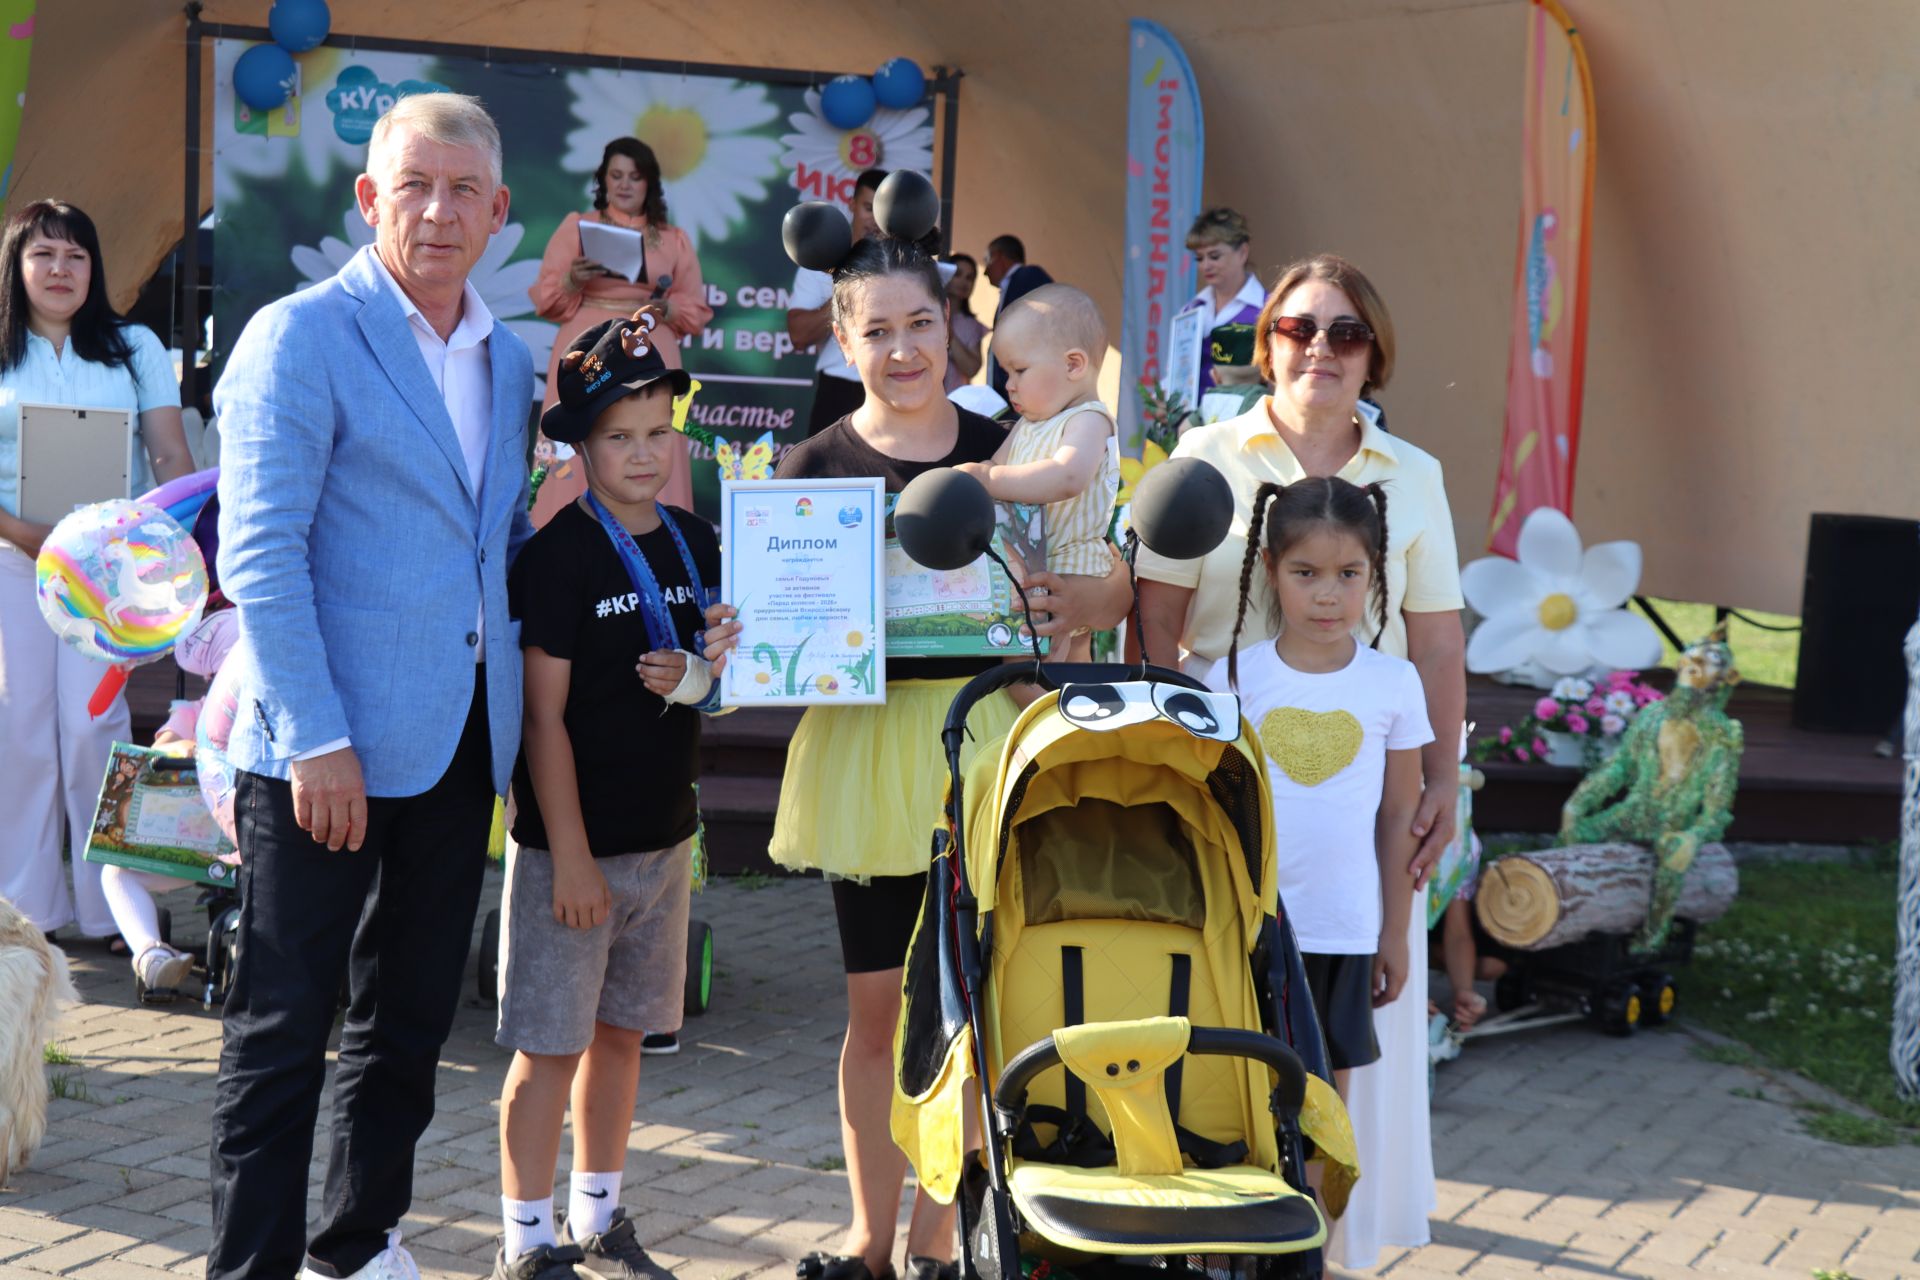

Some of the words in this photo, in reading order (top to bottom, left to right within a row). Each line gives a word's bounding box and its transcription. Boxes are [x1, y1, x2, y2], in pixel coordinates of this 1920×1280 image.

[849, 133, 877, 166] 8
[736, 285, 794, 310] сем
[691, 403, 795, 429] частье
[766, 536, 837, 552] Диплом
